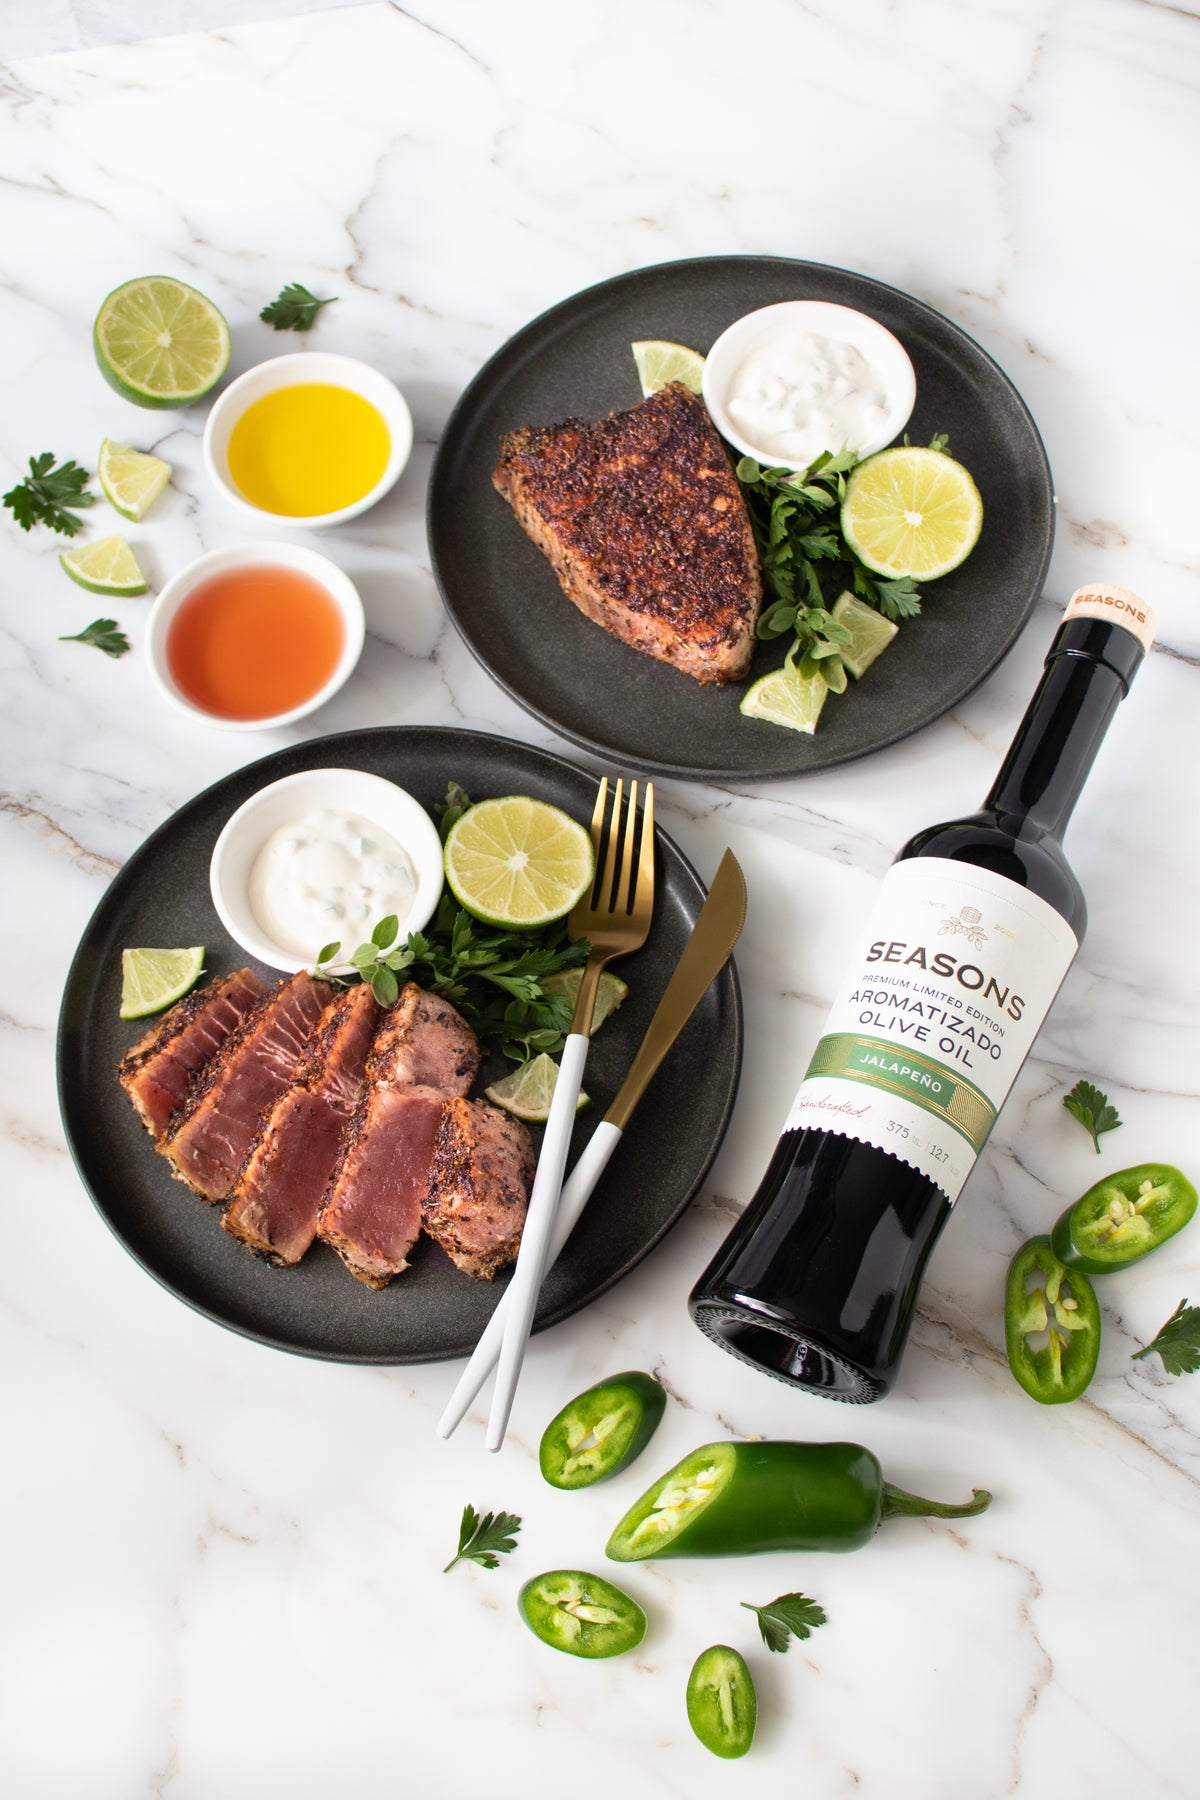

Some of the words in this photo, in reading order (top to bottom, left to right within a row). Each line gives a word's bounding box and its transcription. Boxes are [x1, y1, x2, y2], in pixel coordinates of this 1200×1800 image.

[1074, 594, 1146, 624] SEASONS
[862, 974, 910, 989] PREMIUM
[913, 983, 963, 1009] LIMITED
[965, 1006, 1006, 1037] EDITION
[865, 941, 1026, 1022] SEASONS
[848, 989, 1002, 1060] AROMATIZADO
[859, 1010, 932, 1042] OLIVE
[938, 1037, 974, 1069] OIL
[859, 1053, 943, 1094] JALAPEÑO
[886, 1119, 910, 1139] 375
[929, 1144, 950, 1164] 12.7
